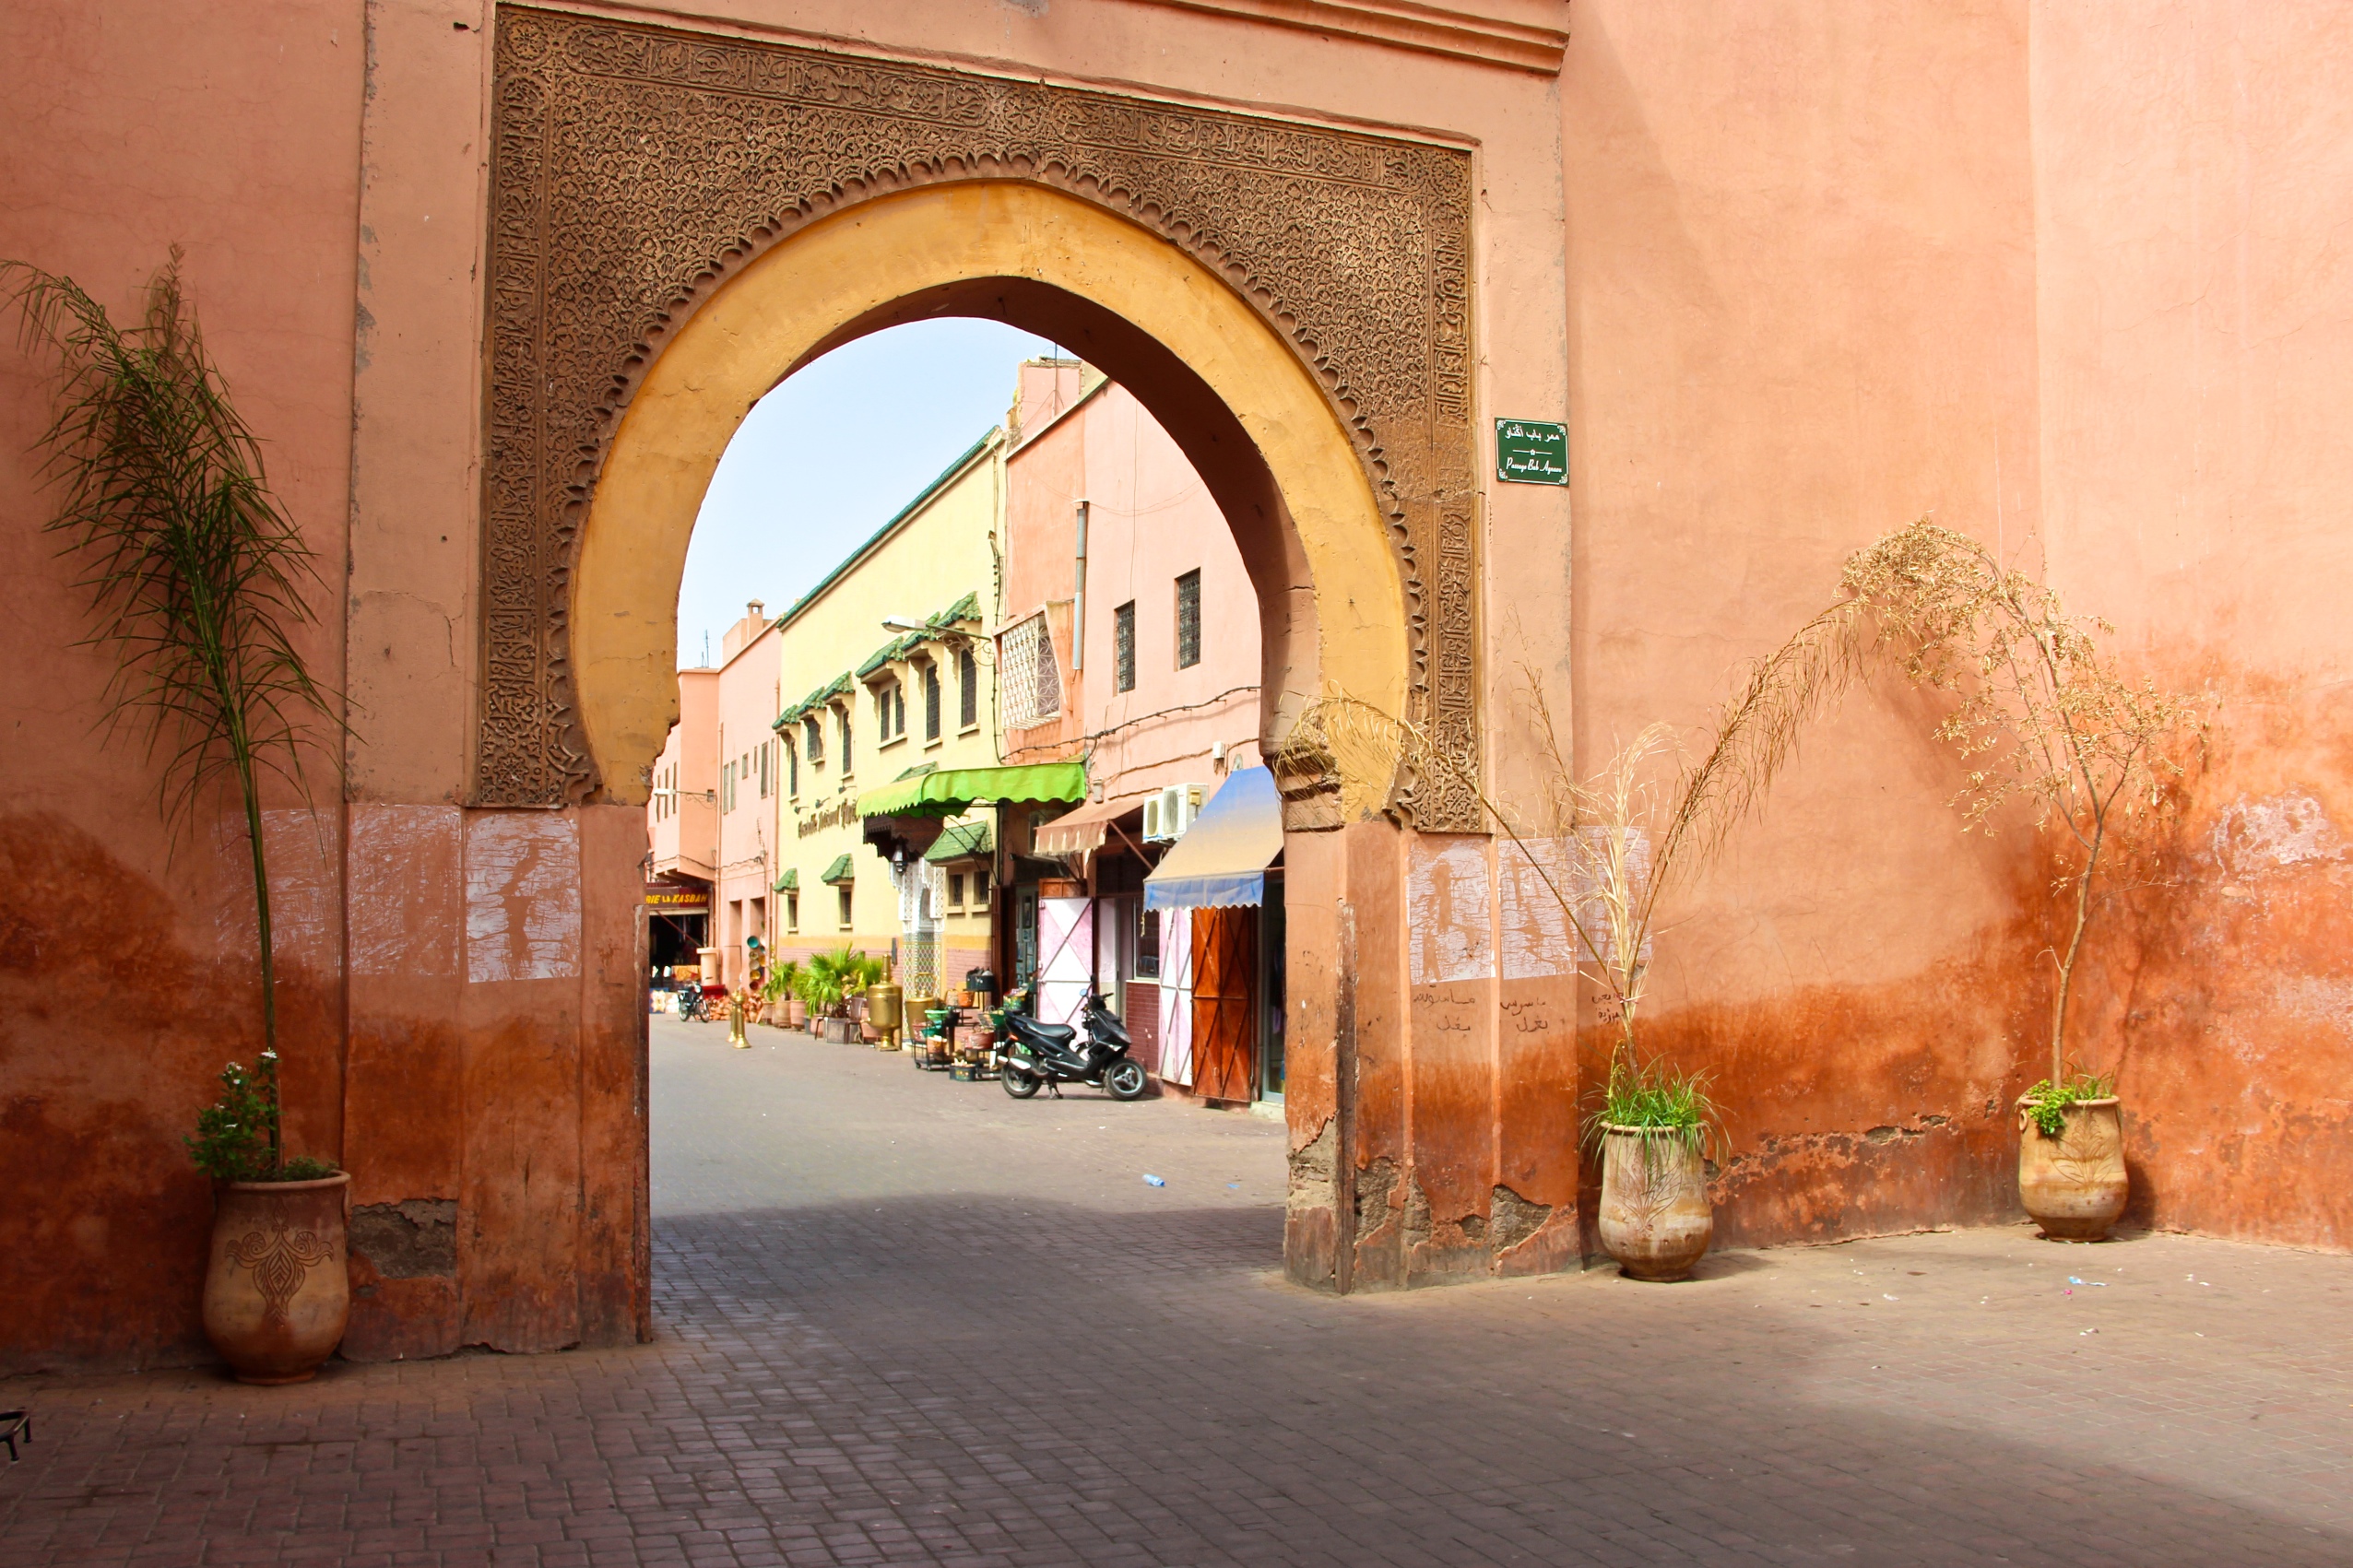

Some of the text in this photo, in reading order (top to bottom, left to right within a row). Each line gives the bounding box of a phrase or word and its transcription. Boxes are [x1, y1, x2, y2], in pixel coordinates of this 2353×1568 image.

[1526, 429, 1542, 442] باب
[1543, 433, 1560, 442] ممر
[1506, 456, 1527, 473] Passage
[1527, 458, 1540, 471] Bab
[672, 894, 708, 903] KASBAH
